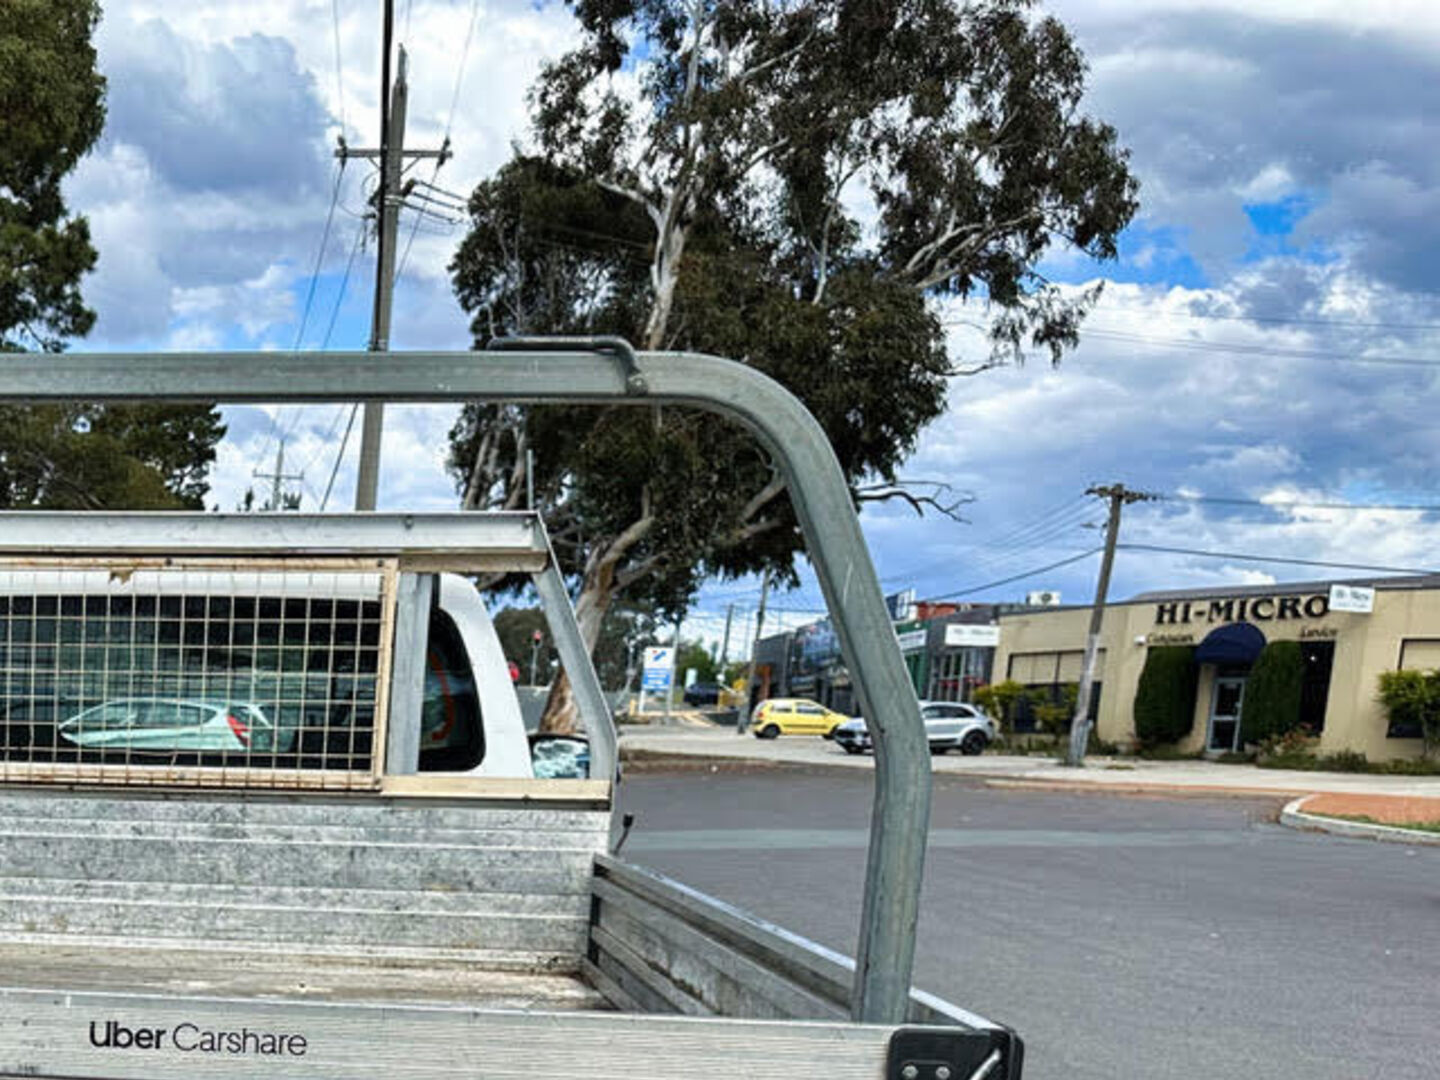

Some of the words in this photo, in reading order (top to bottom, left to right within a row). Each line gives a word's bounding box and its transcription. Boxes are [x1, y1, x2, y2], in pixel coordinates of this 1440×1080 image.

[1156, 595, 1329, 624] HI-MICRO
[89, 1020, 166, 1051] Uber
[173, 1024, 307, 1056] Carshare
